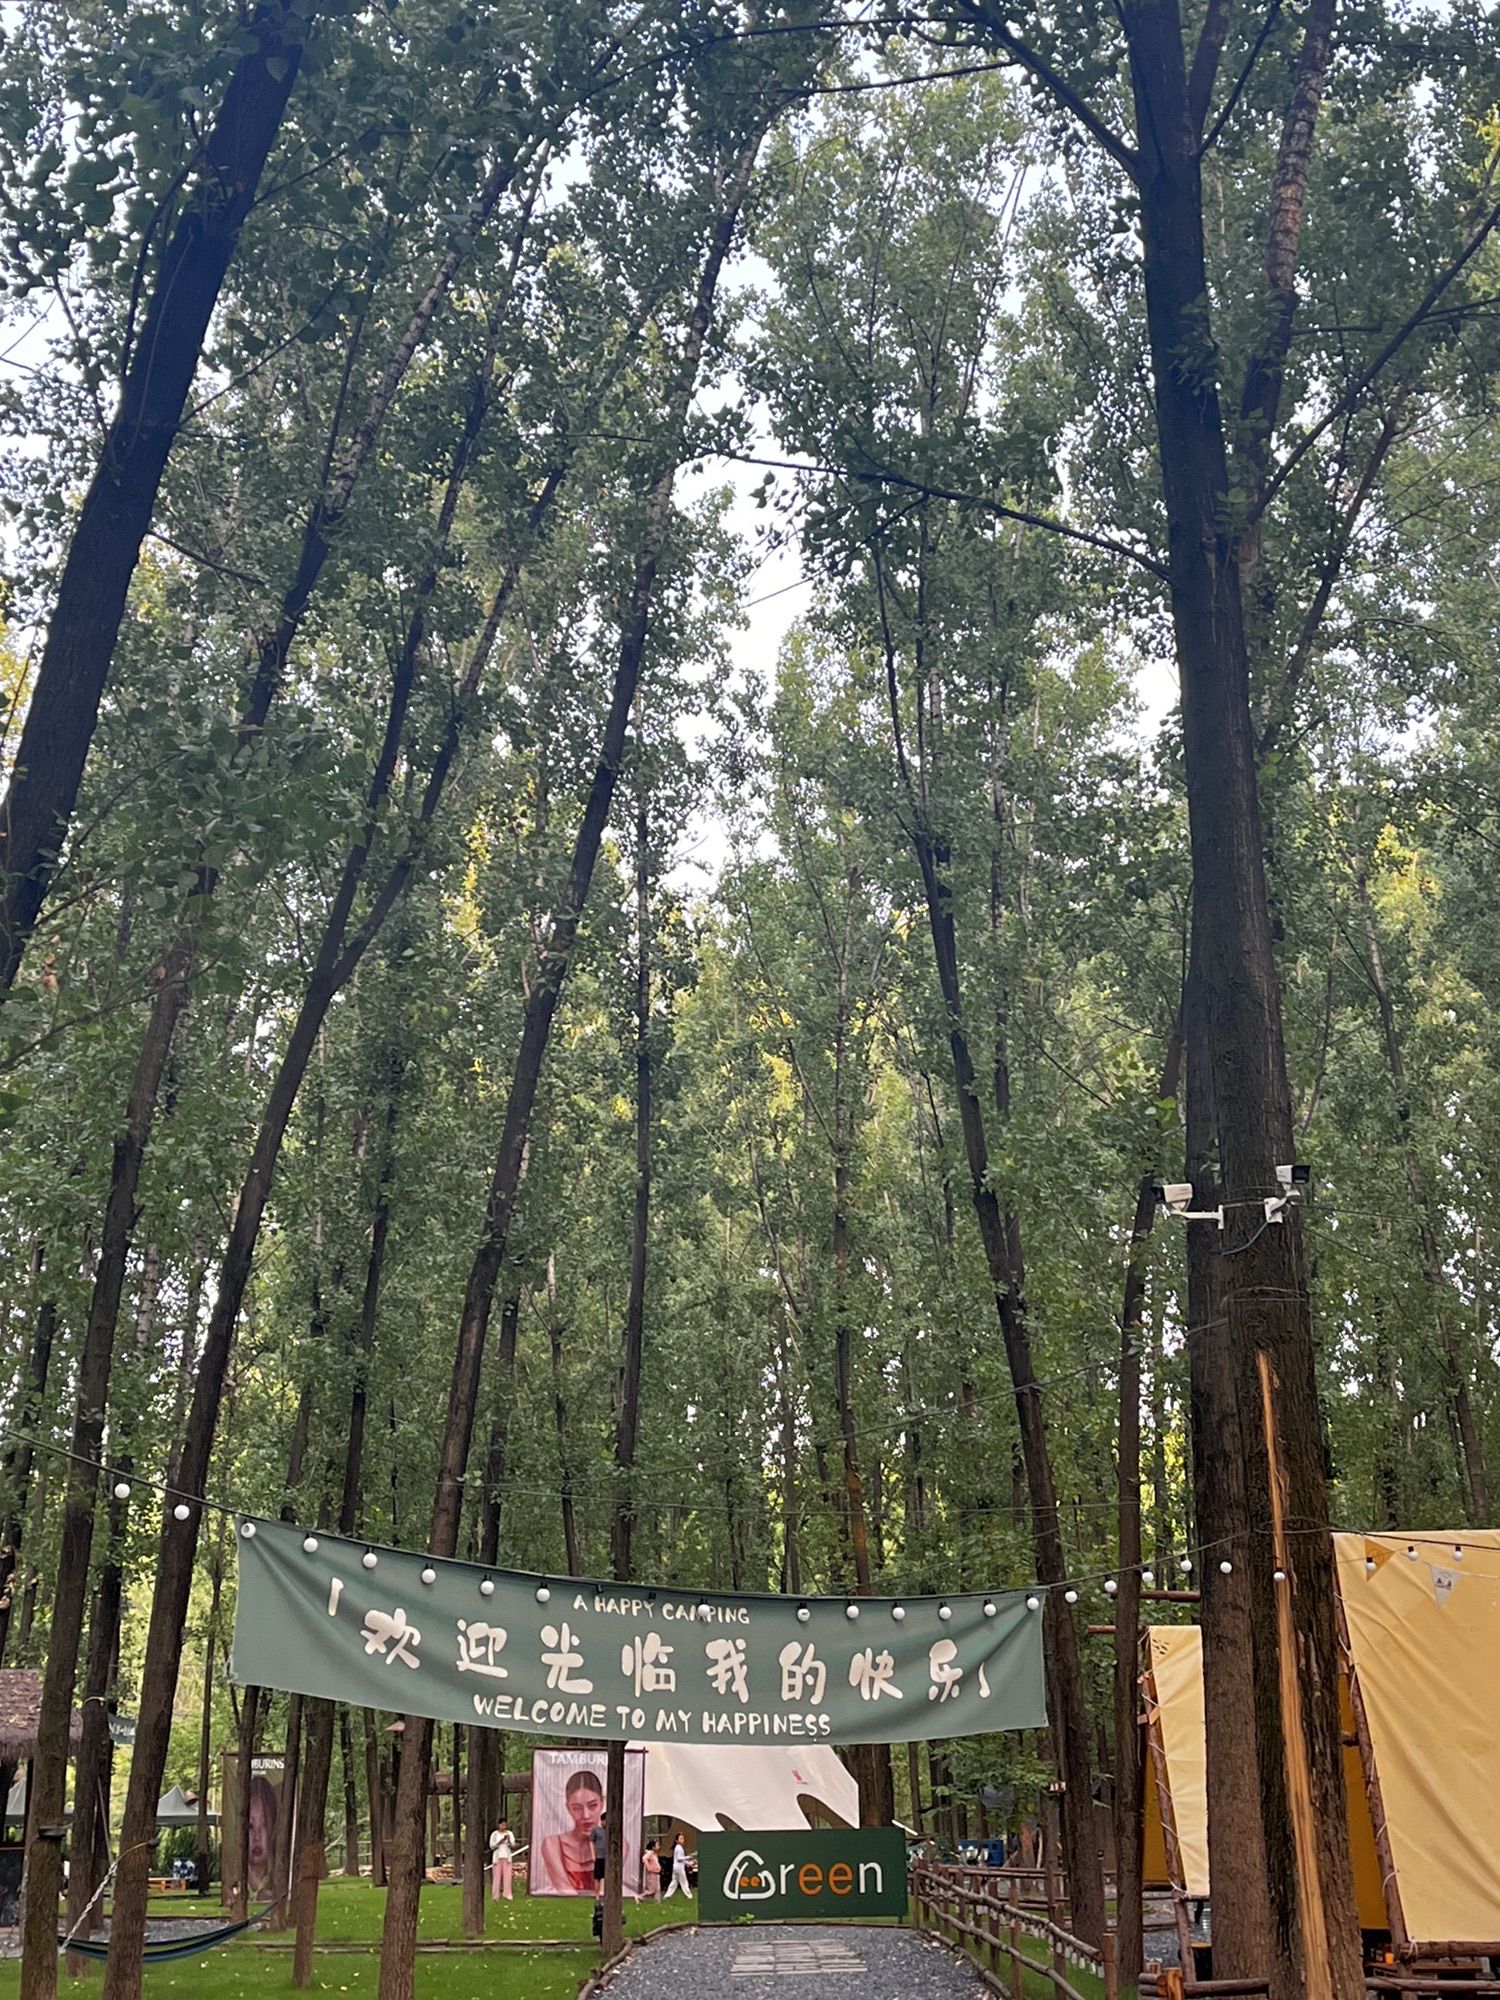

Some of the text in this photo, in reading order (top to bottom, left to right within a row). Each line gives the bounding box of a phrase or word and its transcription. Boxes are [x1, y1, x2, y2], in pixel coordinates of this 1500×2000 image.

[573, 1594, 588, 1611] A
[594, 1595, 655, 1618] HAPPY
[473, 1694, 831, 1736] WELCOME TO MY HAPPINESS
[722, 1849, 883, 1900] Green
